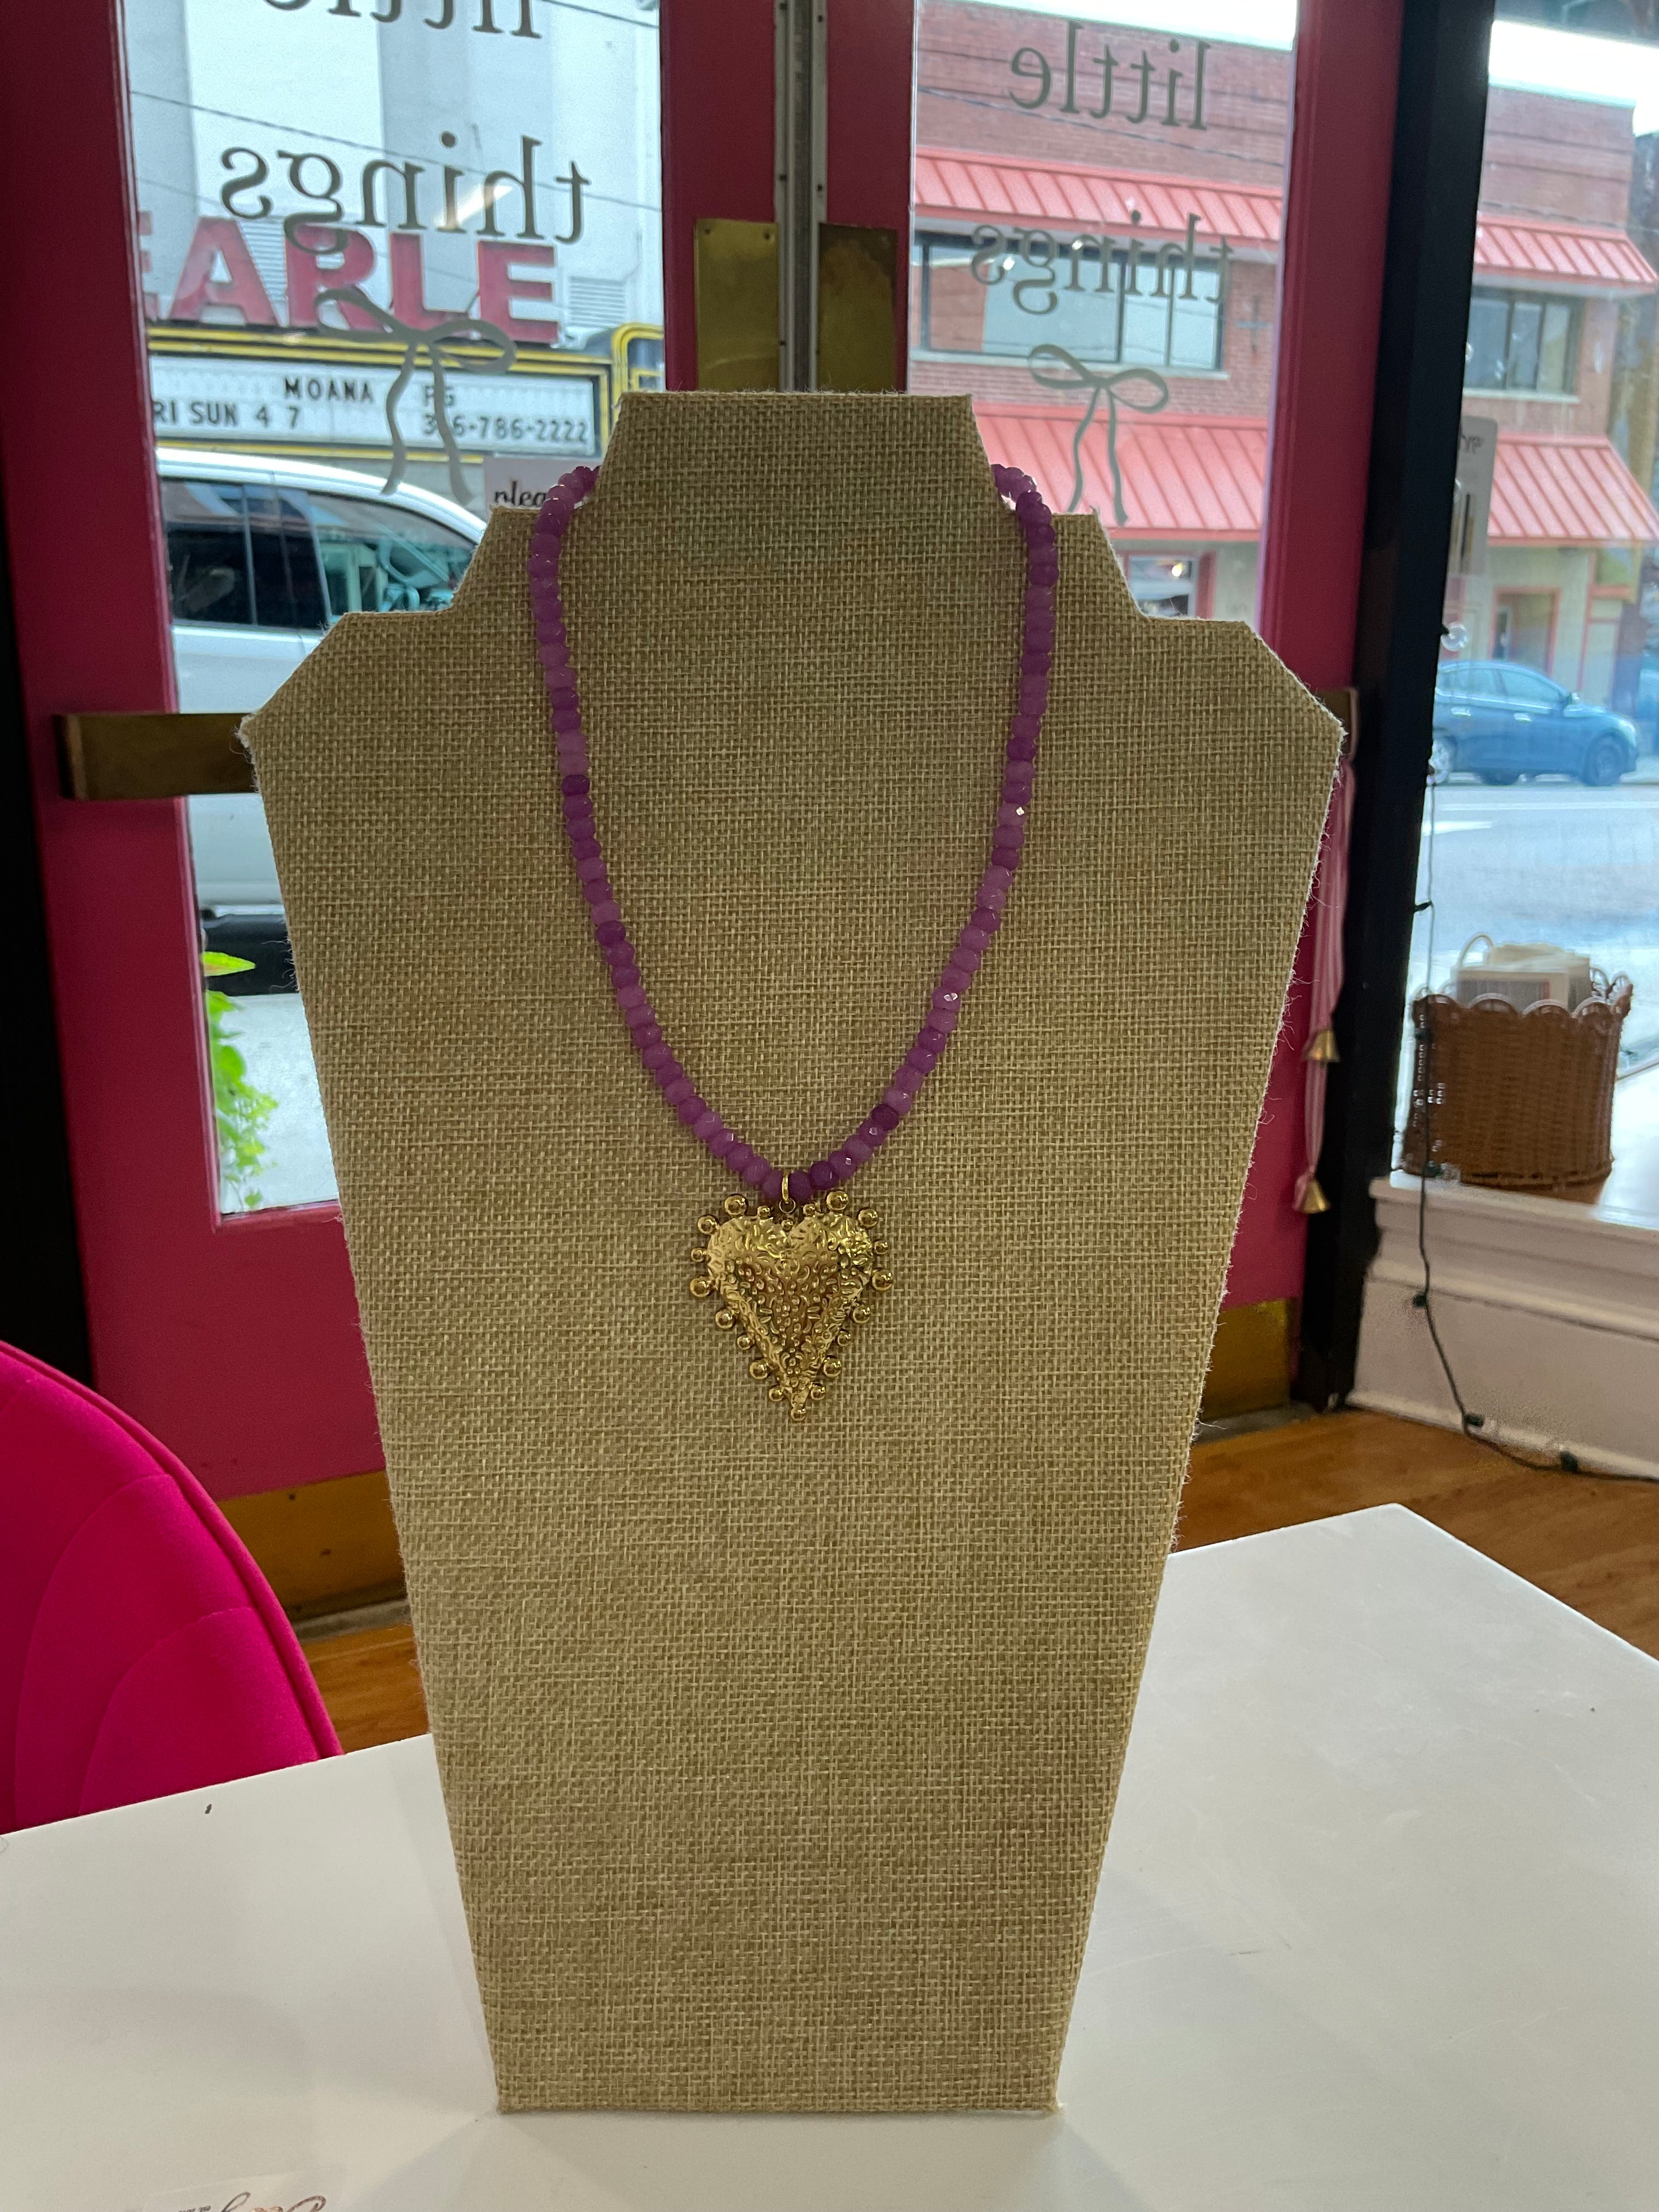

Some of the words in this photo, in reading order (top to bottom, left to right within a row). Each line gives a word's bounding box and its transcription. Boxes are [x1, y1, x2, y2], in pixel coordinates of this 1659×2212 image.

[138, 210, 560, 345] ARLE
[285, 376, 374, 404] MOANA
[190, 401, 238, 426] SUN
[255, 403, 269, 427] 4
[286, 405, 301, 430] 7
[424, 414, 587, 444] 36-786-2222
